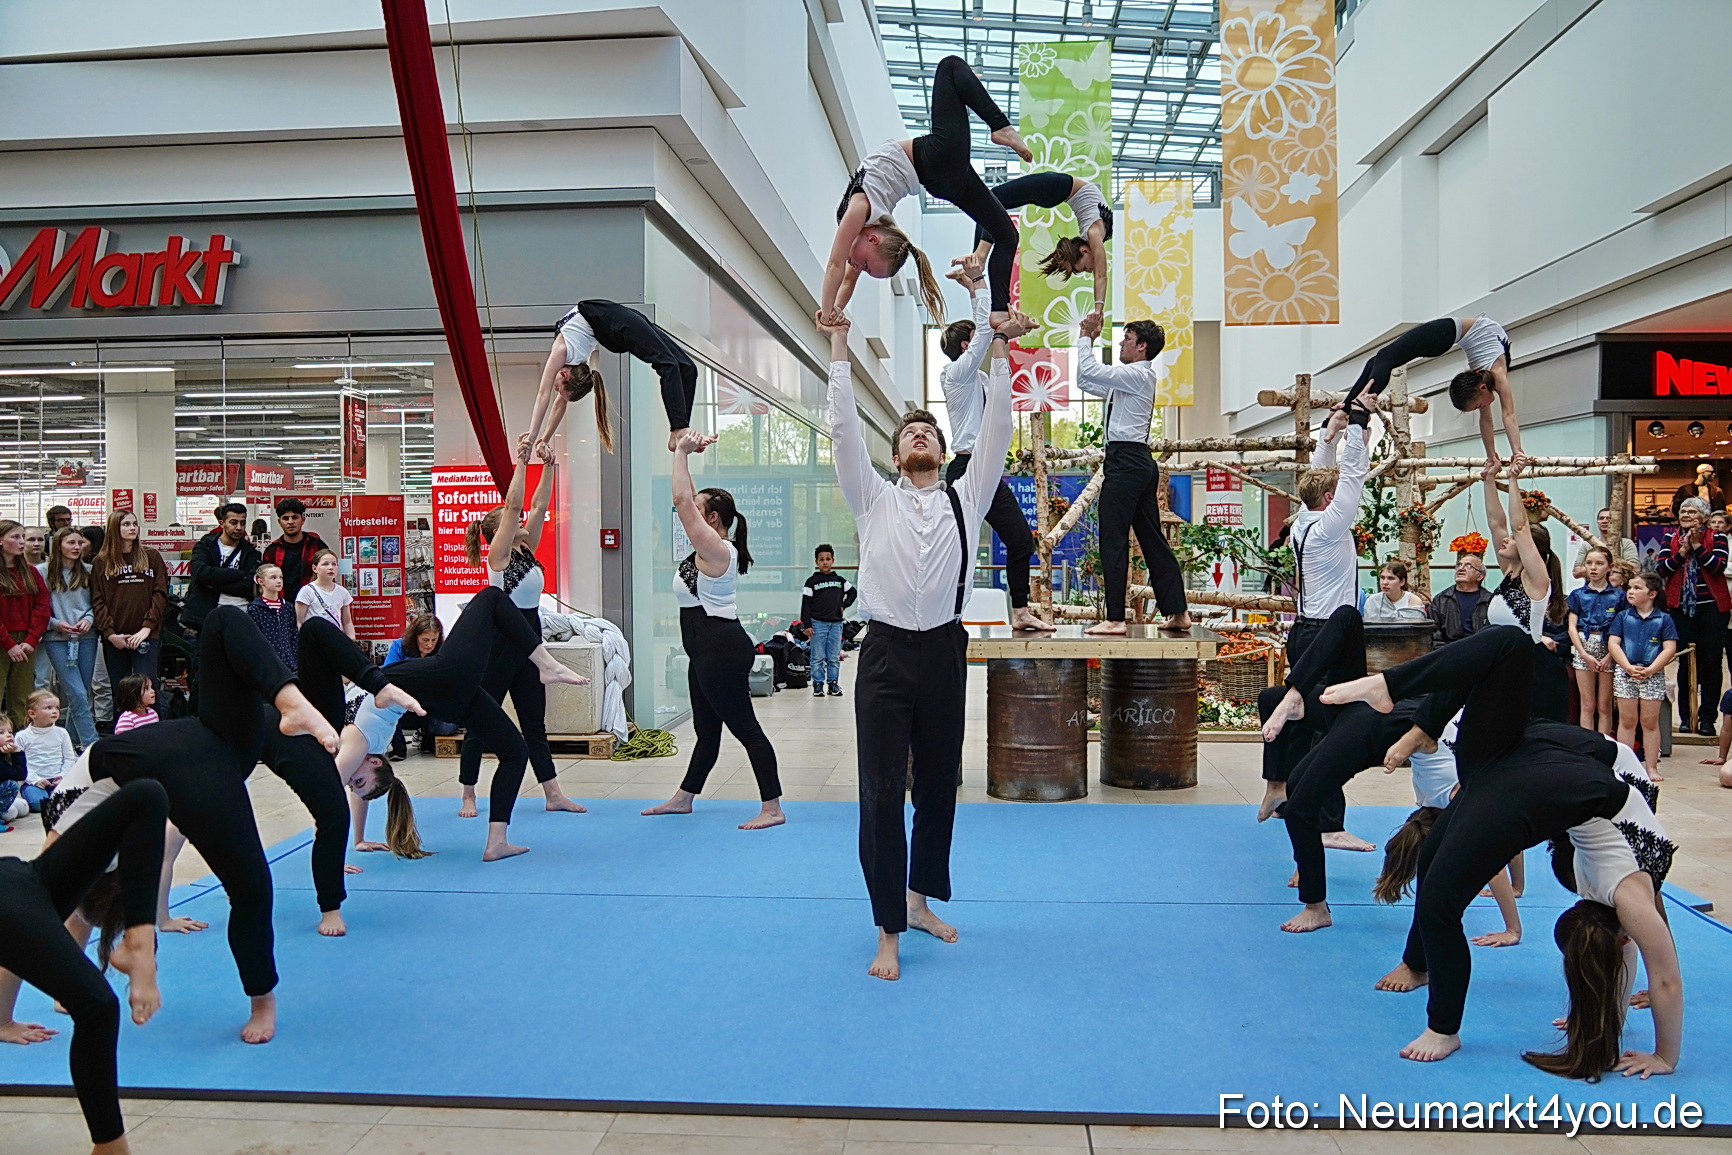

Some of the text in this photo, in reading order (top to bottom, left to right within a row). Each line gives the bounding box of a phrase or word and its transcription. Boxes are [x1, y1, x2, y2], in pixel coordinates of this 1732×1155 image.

[0, 226, 241, 310] Markt
[176, 469, 222, 483] artbar
[251, 470, 284, 485] Smartbar
[437, 475, 483, 483] MediaMarkt
[67, 498, 106, 506] GROßGER
[437, 491, 504, 505] Soforthilf
[438, 509, 459, 522] für
[1206, 505, 1229, 515] REWE
[344, 517, 397, 526] Vorbesteller
[443, 566, 484, 574] Akkutausch
[1066, 711, 1087, 726] AR
